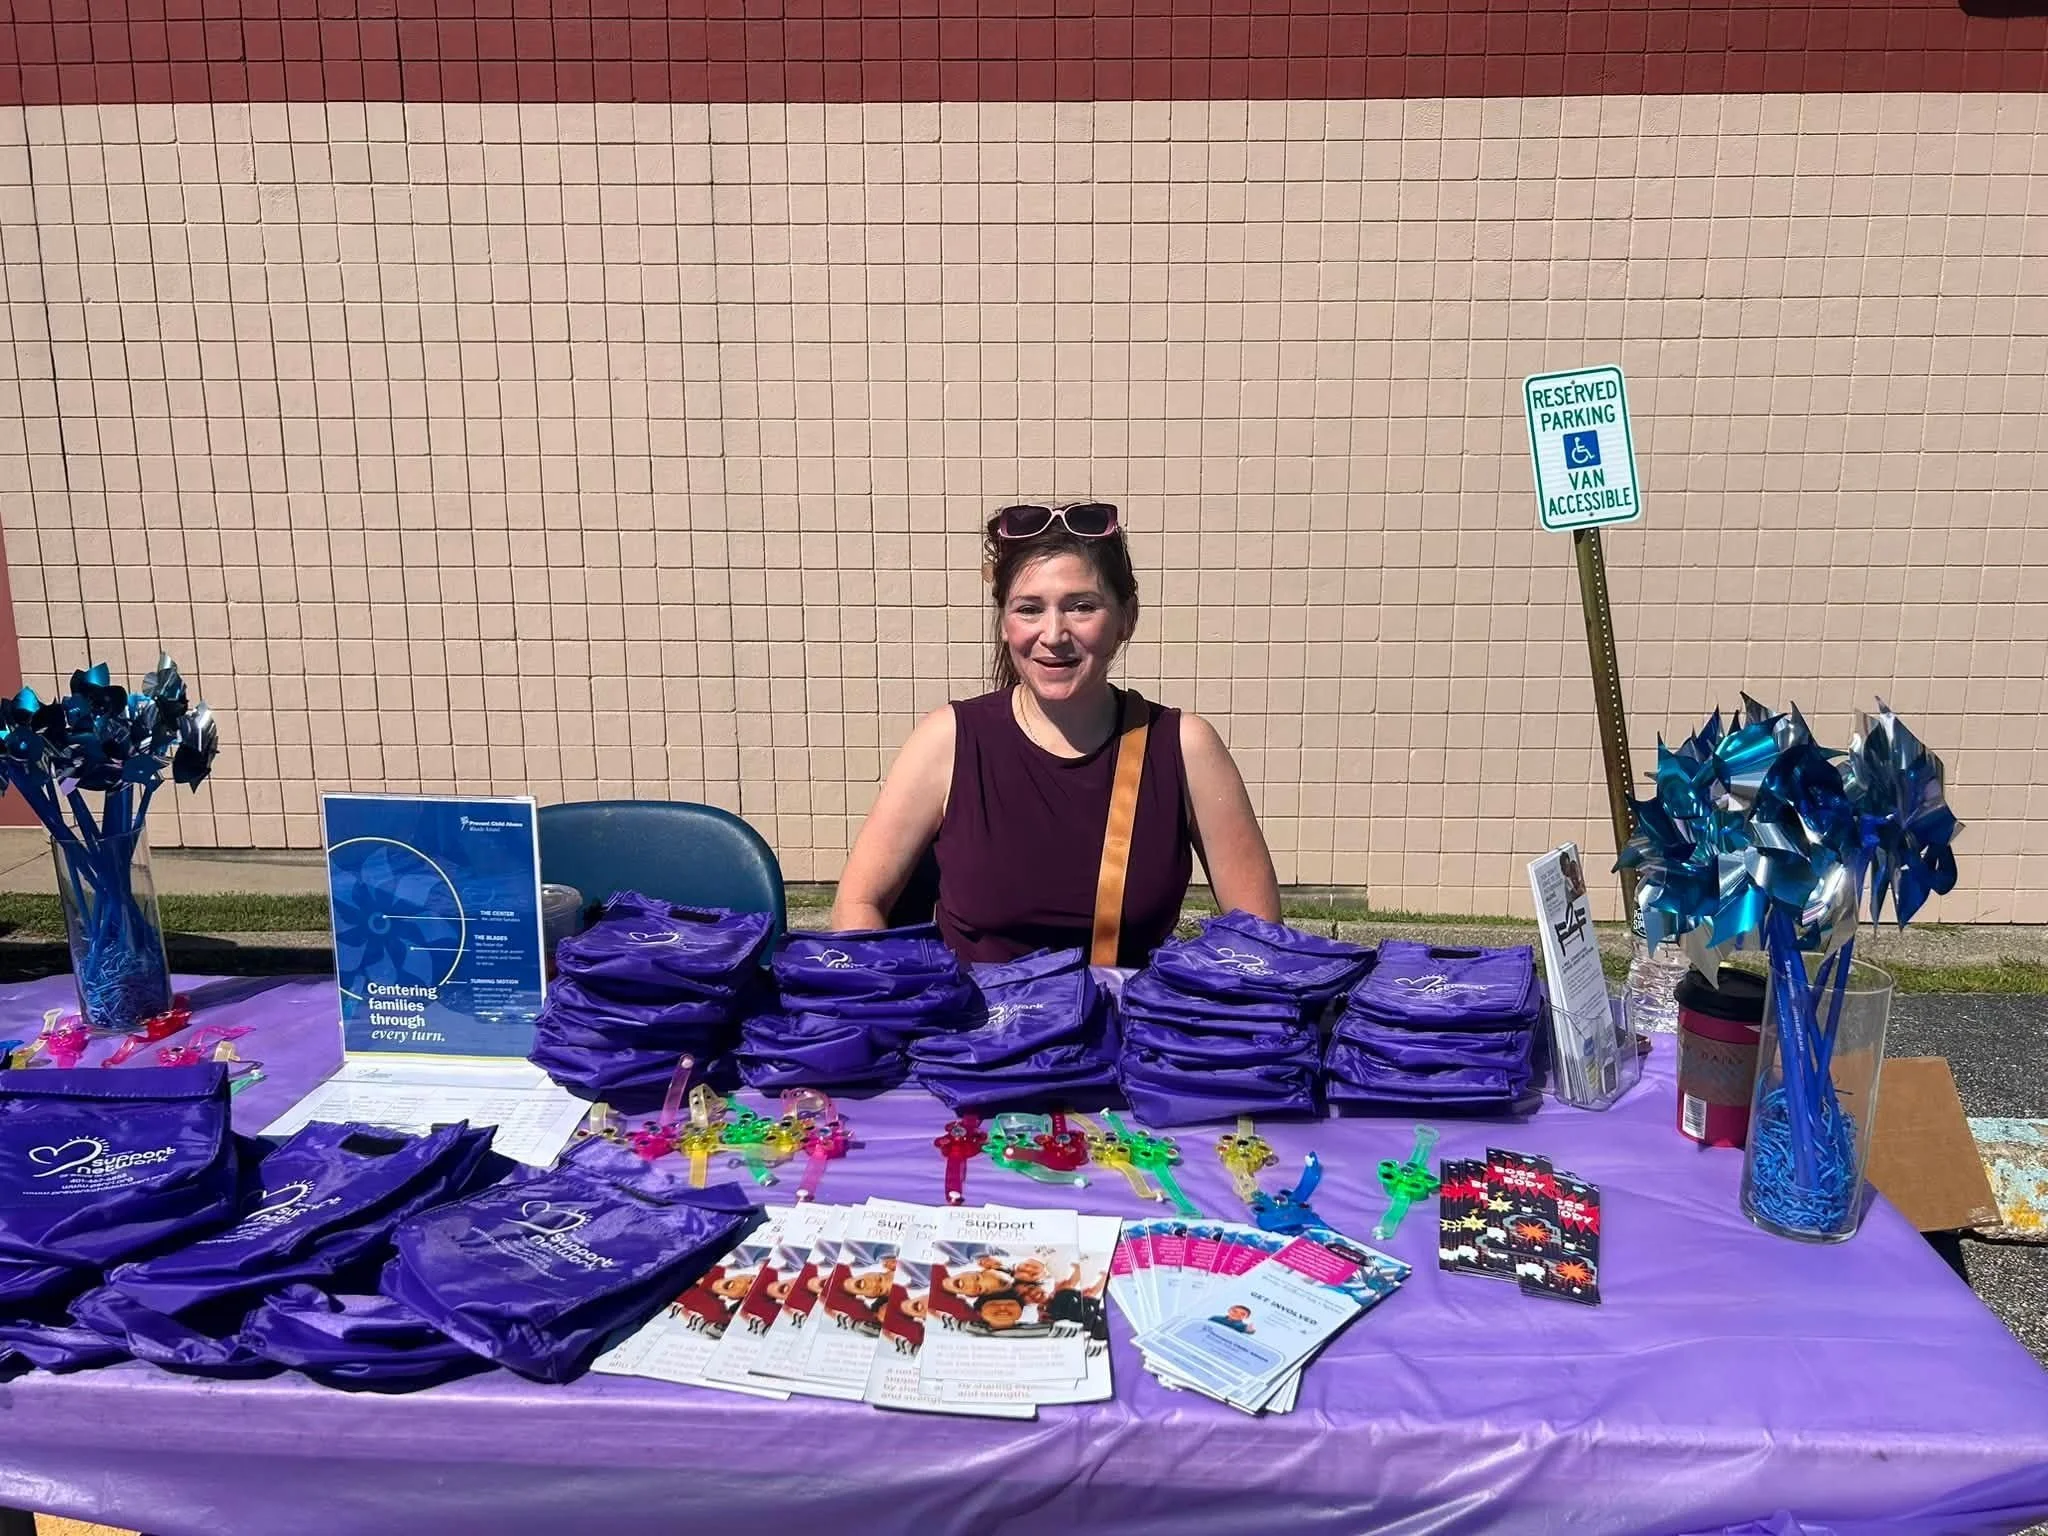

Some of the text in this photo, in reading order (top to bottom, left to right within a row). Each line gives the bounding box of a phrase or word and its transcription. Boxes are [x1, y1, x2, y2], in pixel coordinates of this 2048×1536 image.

[1532, 380, 1617, 409] RESERVED
[1541, 404, 1616, 432] PARKING
[1568, 468, 1605, 491] VAN
[1549, 487, 1632, 517] ACCESSIBLE
[367, 982, 438, 1000] Centering
[368, 998, 425, 1011] families
[369, 1013, 425, 1029] through
[371, 1030, 446, 1043] every turn.
[76, 1155, 169, 1175] network
[91, 1146, 177, 1167] support
[1503, 1176, 1546, 1190] BODY
[965, 1219, 1035, 1231] support
[1557, 1208, 1593, 1224] ODY
[529, 1234, 597, 1271] network
[549, 1232, 615, 1268] support
[1250, 1291, 1267, 1305] GET
[1270, 1299, 1318, 1327] INVOLVED
